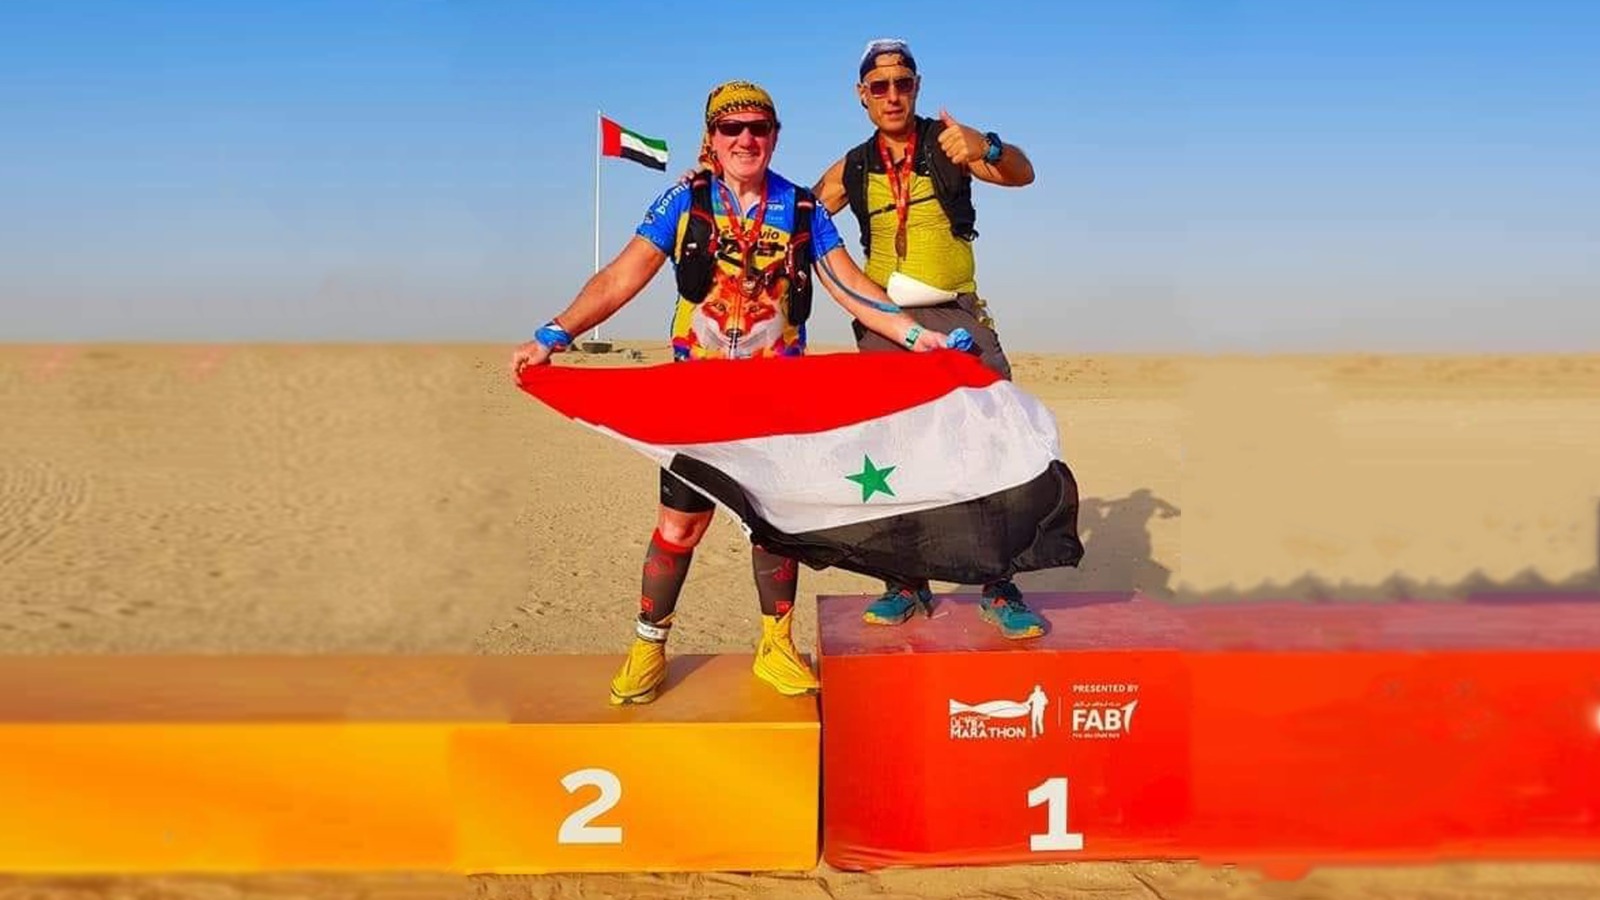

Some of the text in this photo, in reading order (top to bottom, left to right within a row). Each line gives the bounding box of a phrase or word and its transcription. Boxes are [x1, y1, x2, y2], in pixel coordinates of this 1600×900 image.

[1073, 684, 1139, 692] PRESENTED BY
[1073, 709, 1122, 731] FAB
[950, 727, 1026, 738] MARATHON
[558, 768, 622, 843] 2
[1028, 777, 1084, 852] 1
